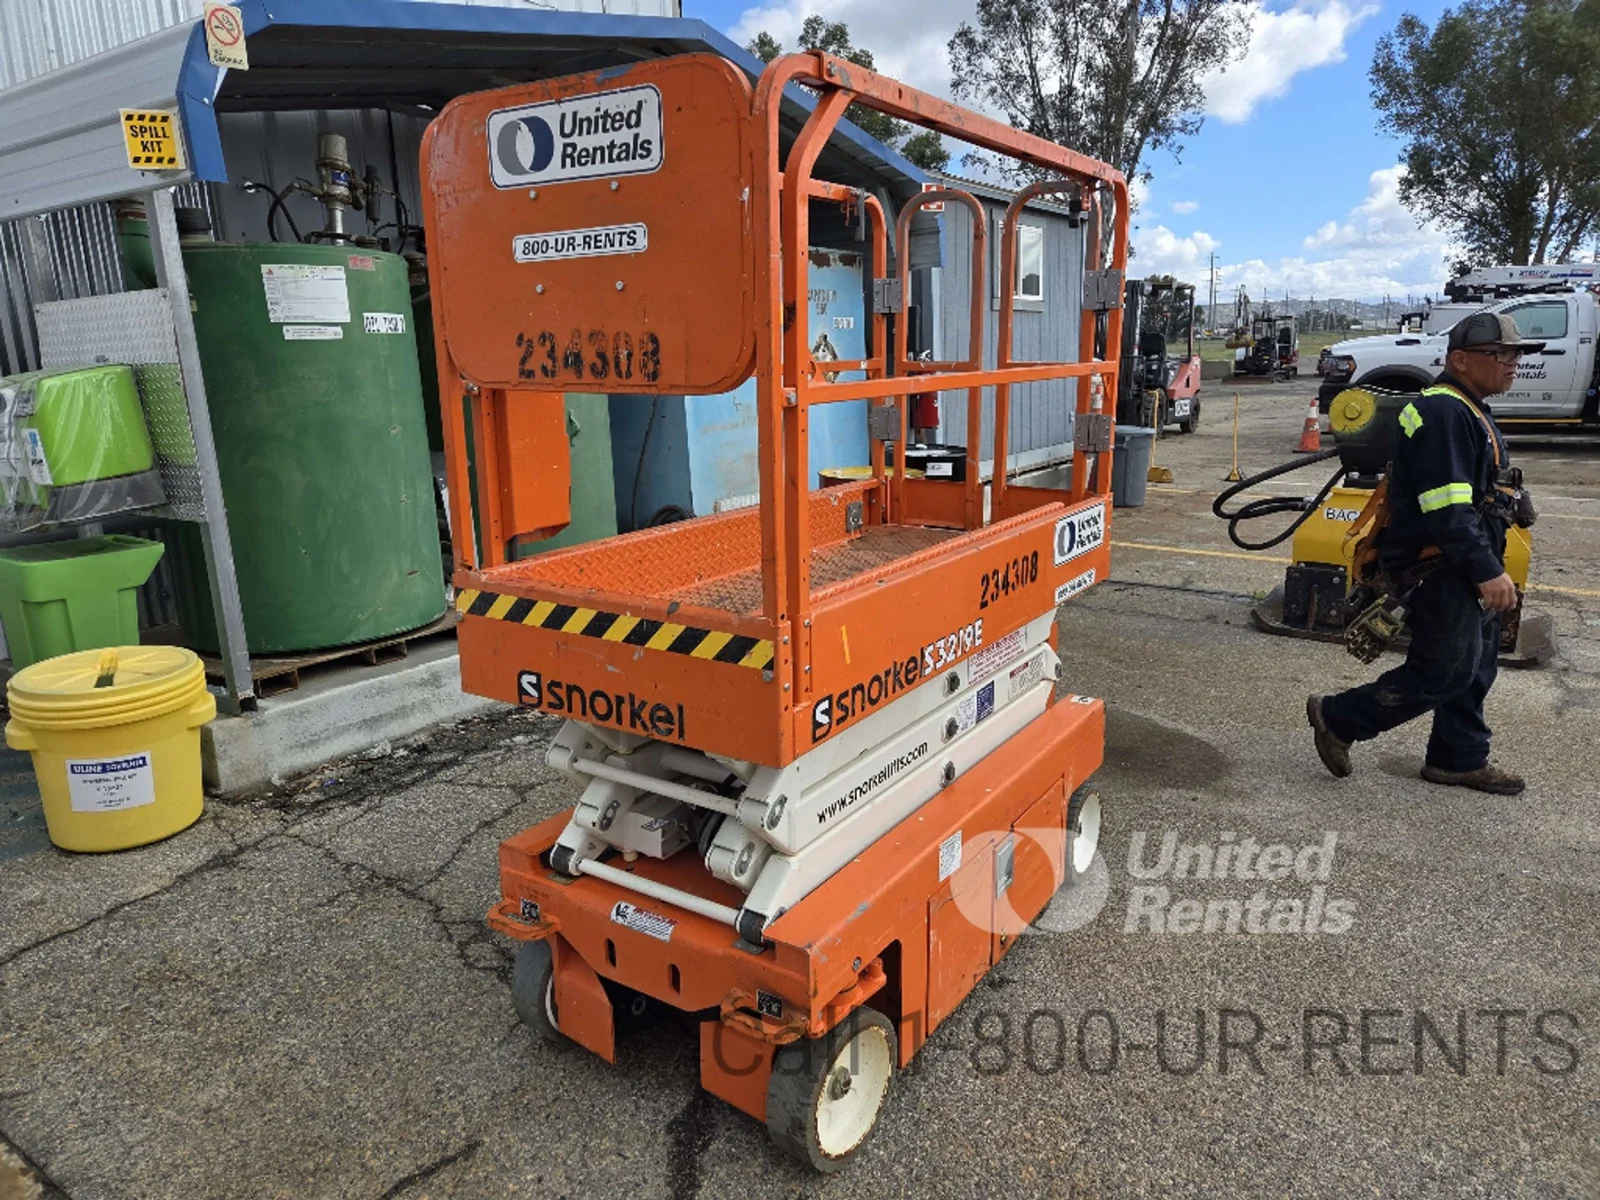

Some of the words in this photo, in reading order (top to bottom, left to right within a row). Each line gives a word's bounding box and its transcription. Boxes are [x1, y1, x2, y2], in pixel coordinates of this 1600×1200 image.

[129, 125, 170, 139] SPILL
[559, 100, 643, 139] United
[140, 140, 163, 153] KIT
[561, 133, 653, 169] Rentals
[522, 229, 637, 256] 800-UR-RENTS
[516, 329, 661, 382] 234308
[1516, 361, 1545, 370] nited
[1514, 370, 1547, 379] entals
[1326, 508, 1358, 522] BAC
[980, 550, 1038, 610] 234308
[836, 647, 925, 727] snorkel
[547, 679, 685, 741] snorkel
[73, 765, 102, 773] ULINE
[816, 741, 928, 825] www.snorkellifts.com
